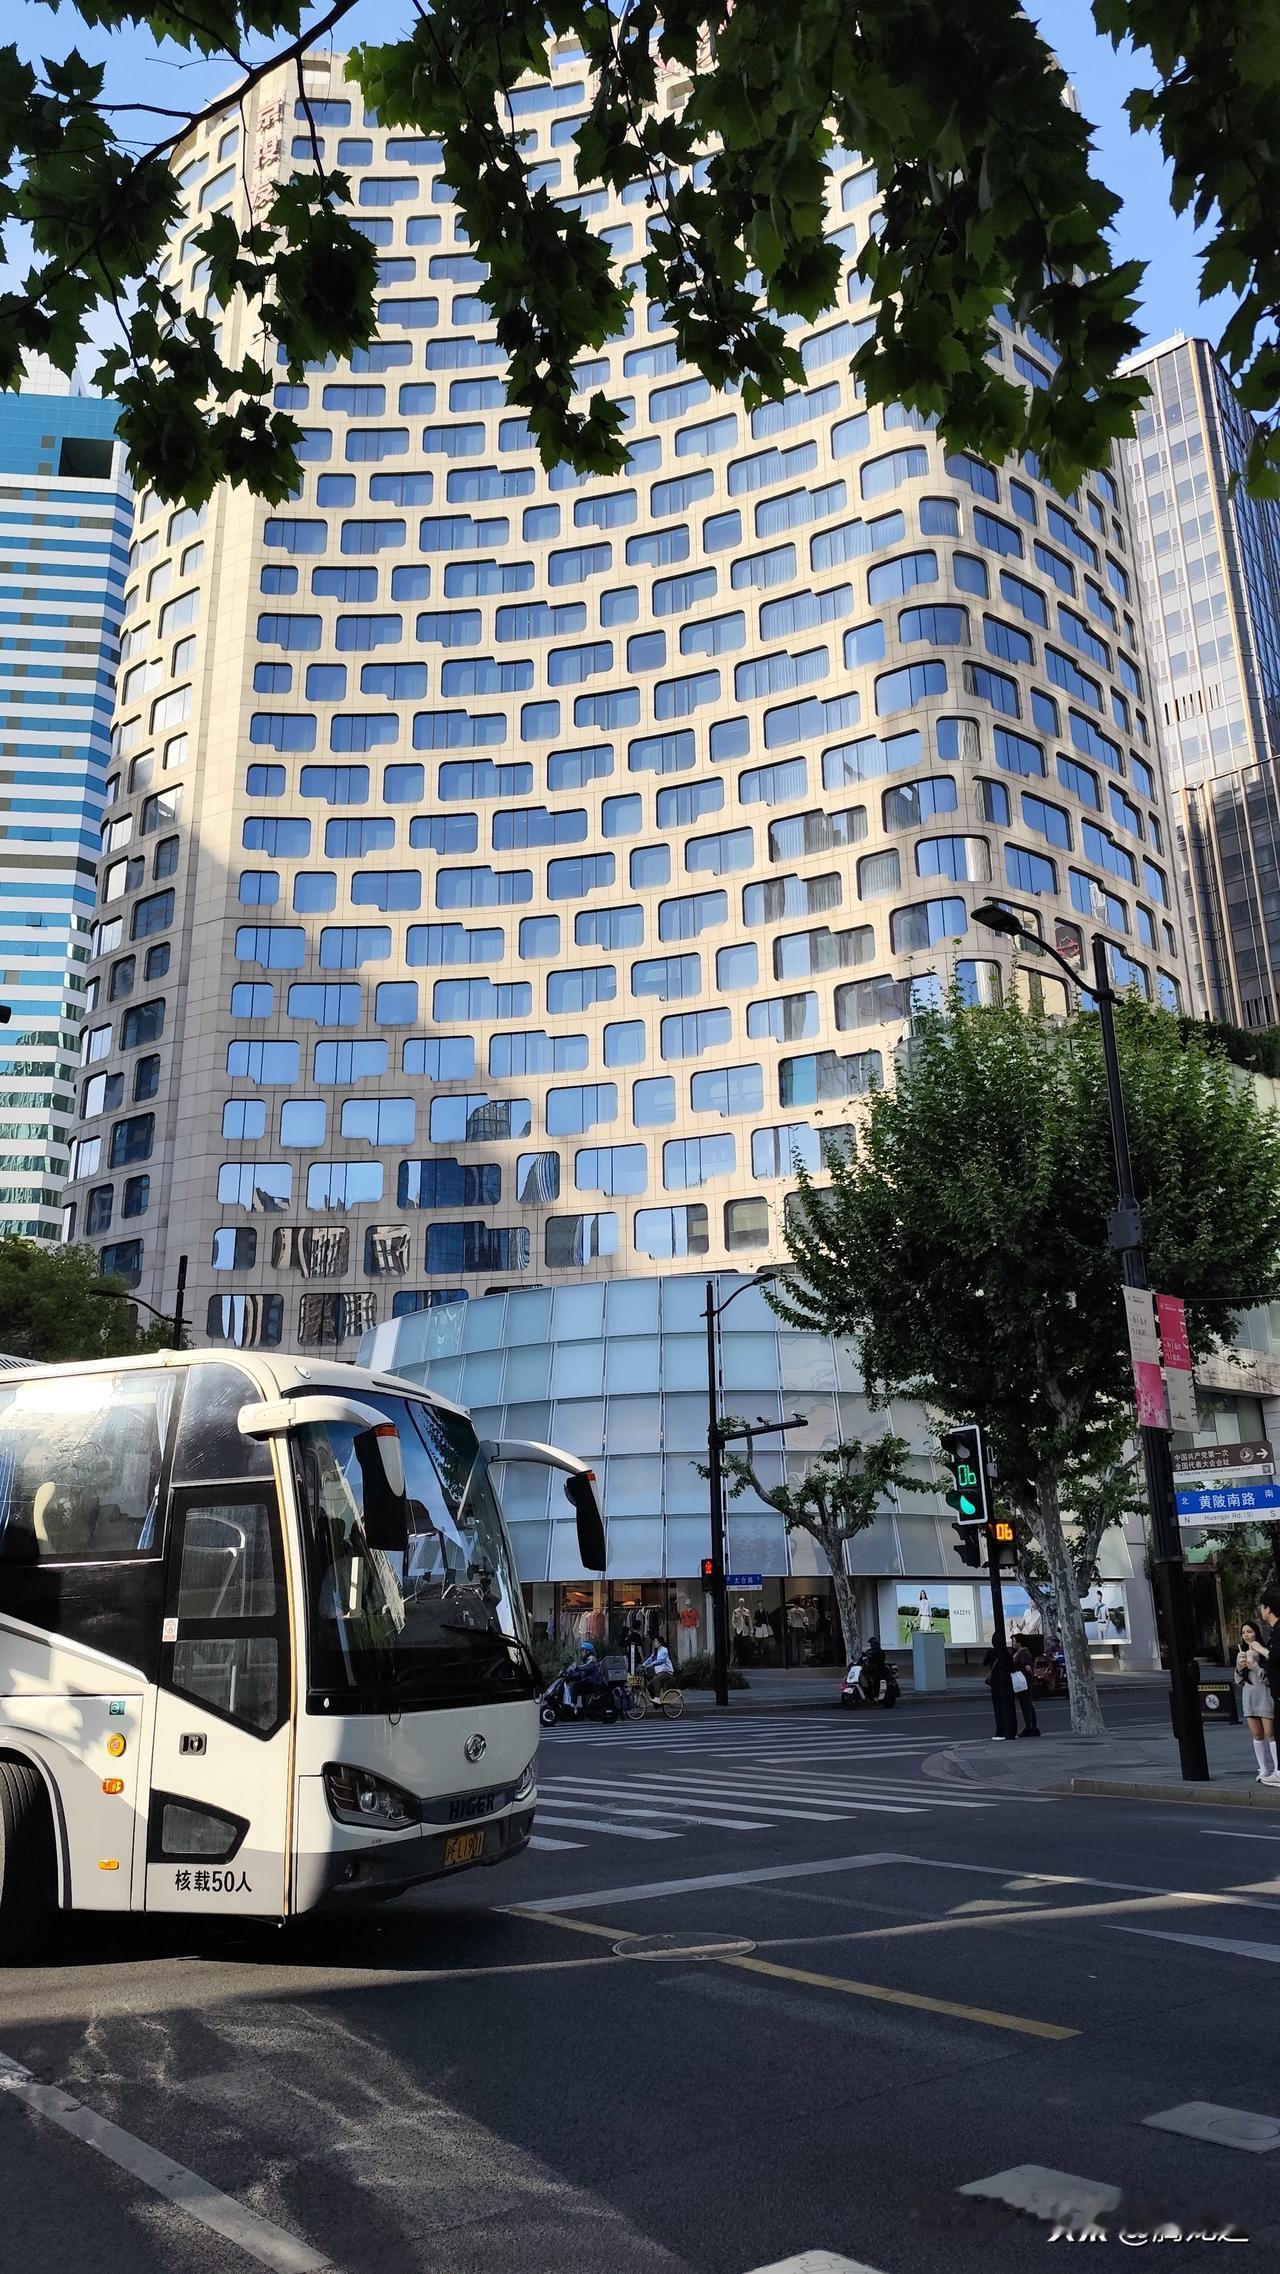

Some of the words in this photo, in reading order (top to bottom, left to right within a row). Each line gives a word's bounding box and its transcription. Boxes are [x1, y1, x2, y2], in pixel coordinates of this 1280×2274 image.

[1174, 1449, 1229, 1462] 中国共产党第一次
[1175, 1458, 1230, 1471] 全国代表大会会址
[1181, 1497, 1190, 1505] 北
[1198, 1491, 1255, 1509] 黄陂南路
[1264, 1489, 1274, 1498] 南
[1184, 1516, 1190, 1524] N
[1270, 1510, 1276, 1518] S
[449, 1793, 495, 1819] HIGER
[175, 1869, 253, 1893] 核载50人
